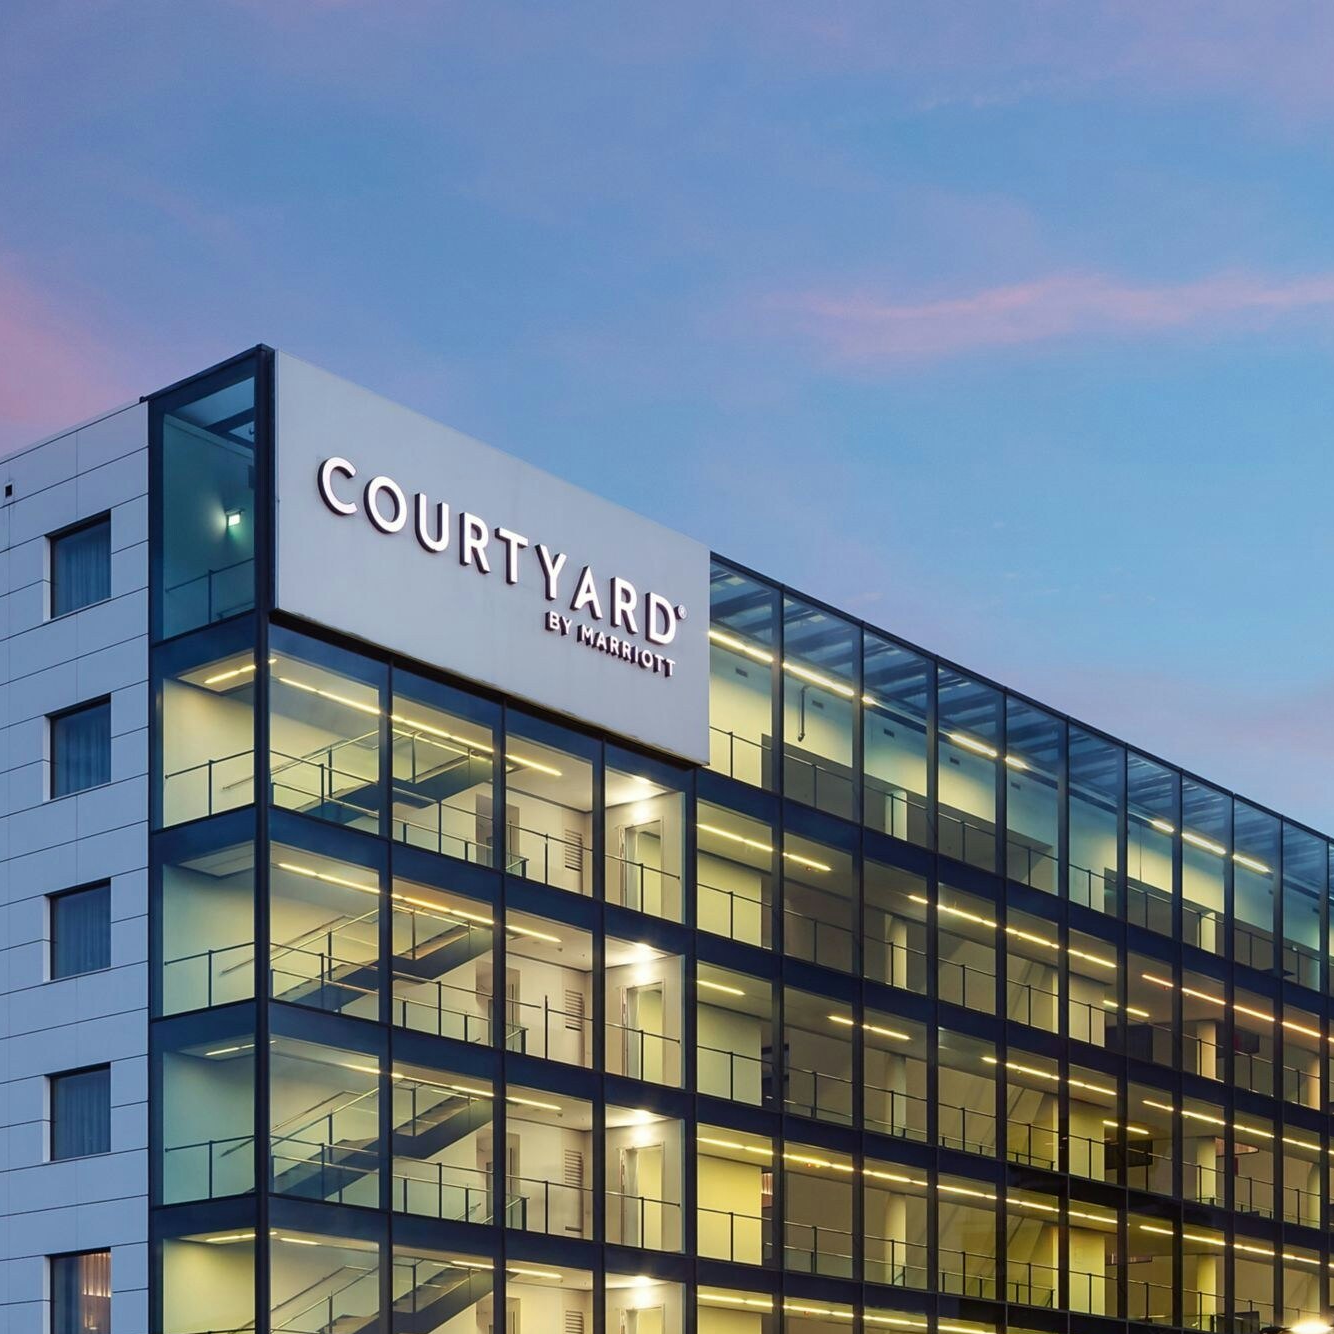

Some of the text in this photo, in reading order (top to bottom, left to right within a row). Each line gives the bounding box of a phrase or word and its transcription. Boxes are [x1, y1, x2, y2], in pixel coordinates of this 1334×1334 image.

[318, 456, 678, 646] COURTYARD
[545, 611, 676, 678] BY MARRIOTT
